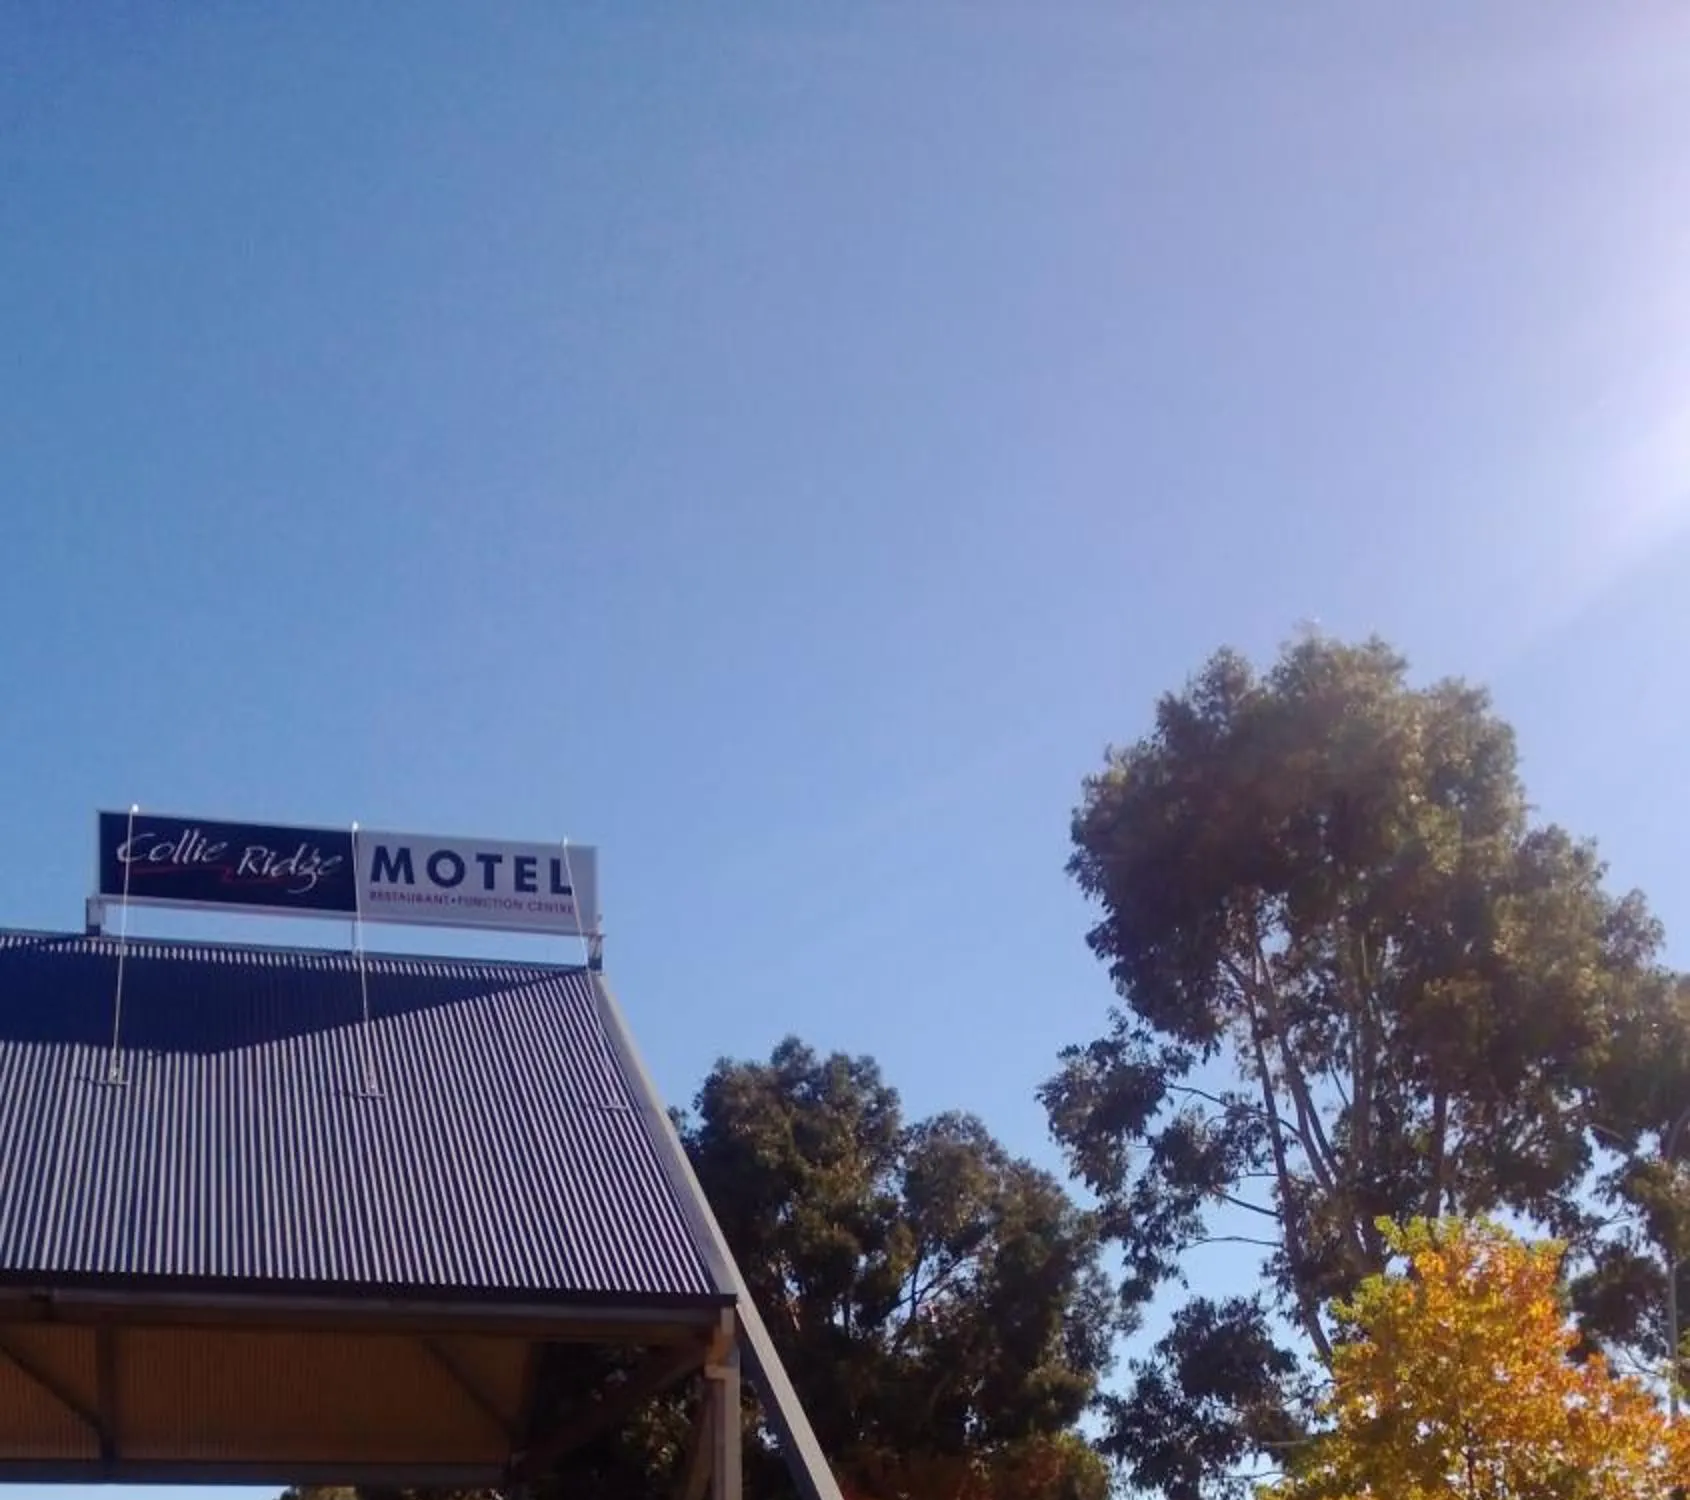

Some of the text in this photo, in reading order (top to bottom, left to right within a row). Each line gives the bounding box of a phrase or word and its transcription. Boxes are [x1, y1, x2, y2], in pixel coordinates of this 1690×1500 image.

[116, 828, 343, 894] Collie Ridge
[370, 845, 573, 896] MOTEL
